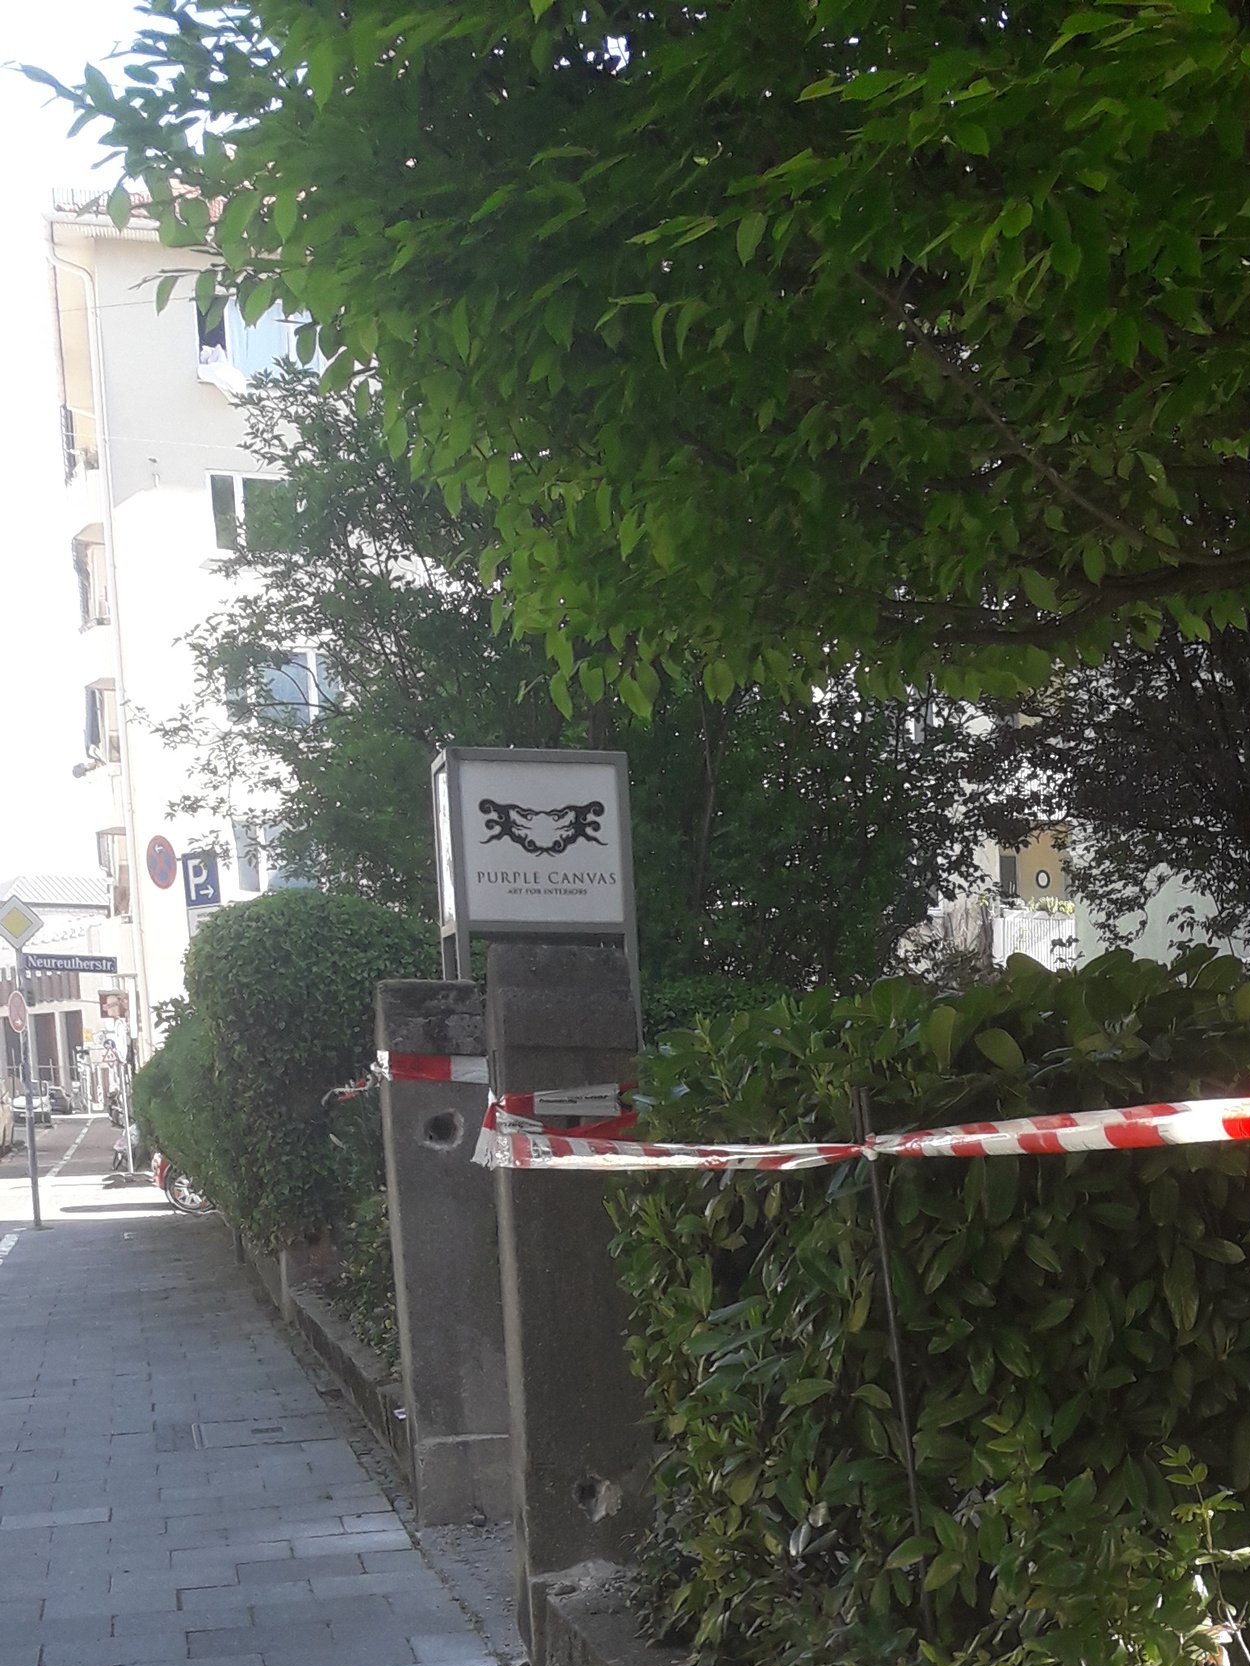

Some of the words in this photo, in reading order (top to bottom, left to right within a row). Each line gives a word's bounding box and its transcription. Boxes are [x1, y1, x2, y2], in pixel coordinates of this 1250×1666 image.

[187, 859, 208, 900] P
[477, 871, 541, 885] PURPLE
[548, 871, 617, 885] CANVAS
[28, 955, 115, 971] Neureutherstr.
